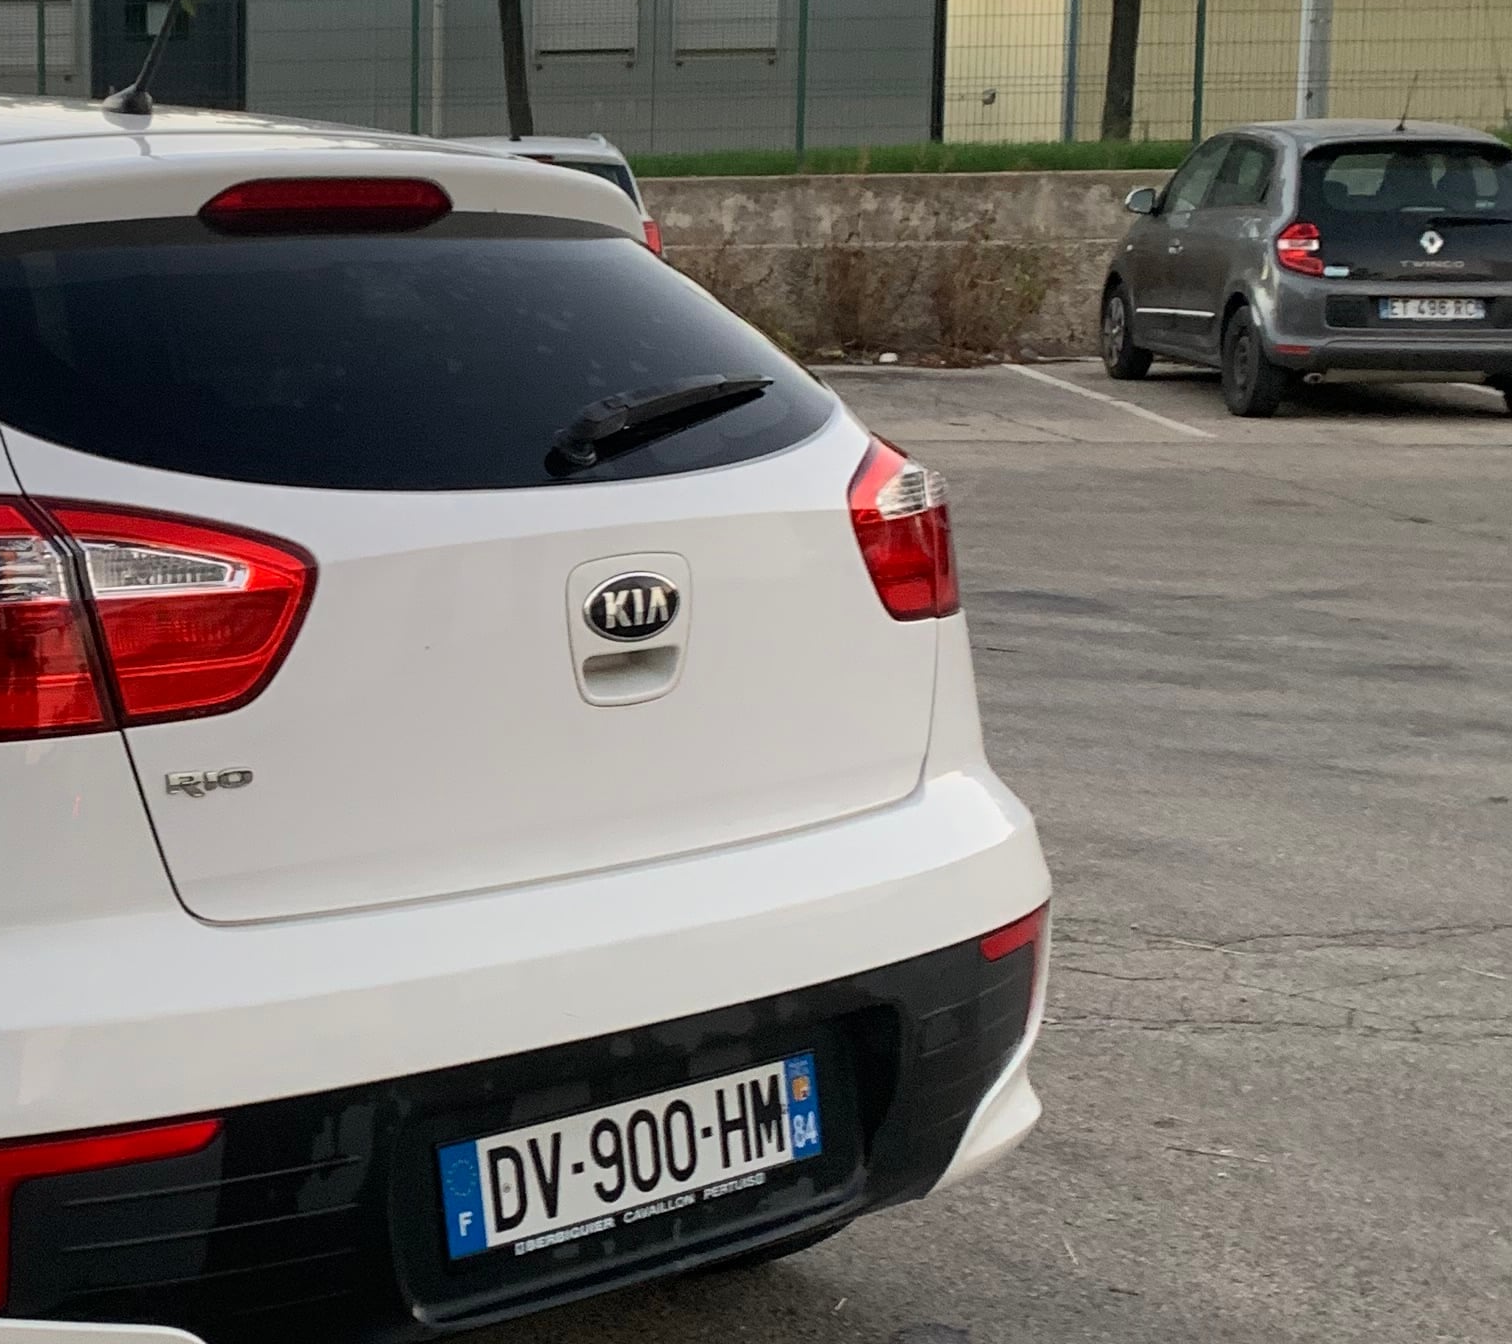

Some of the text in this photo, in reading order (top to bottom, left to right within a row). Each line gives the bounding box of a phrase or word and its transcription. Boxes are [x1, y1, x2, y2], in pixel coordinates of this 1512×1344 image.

[601, 585, 670, 629] KIA
[164, 767, 254, 798] RIO
[793, 1110, 819, 1149] 84
[487, 1073, 787, 1234] DV-900-HM
[458, 1211, 474, 1237] F
[623, 1193, 696, 1223] CAVAILLON
